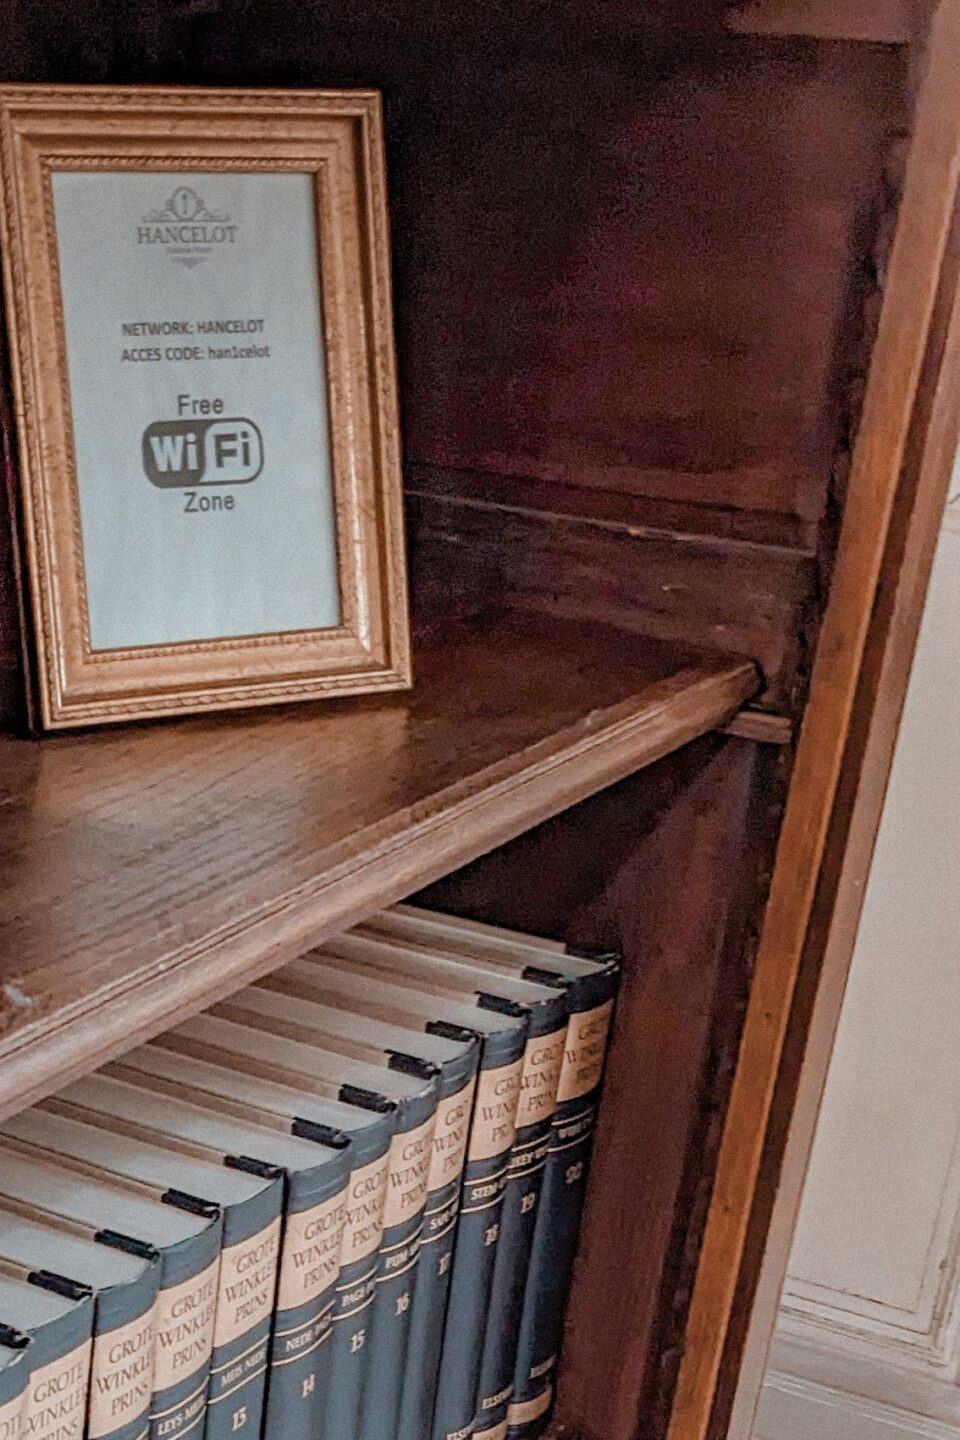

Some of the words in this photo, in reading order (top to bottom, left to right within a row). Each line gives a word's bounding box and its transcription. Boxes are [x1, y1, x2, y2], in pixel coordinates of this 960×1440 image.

[137, 225, 237, 245] HANCELOT
[121, 321, 194, 336] NETWORK:
[196, 319, 265, 334] HANCELOT
[121, 347, 162, 362] ACCES
[164, 346, 205, 361] CODE:
[177, 394, 224, 416] Free
[183, 491, 235, 514] Zone
[304, 1255, 336, 1289] PRINS
[234, 1290, 269, 1325] PRINS
[351, 1330, 365, 1353] 15
[171, 1337, 207, 1371] PRINS
[33, 1360, 83, 1403] GROTE
[301, 1373, 315, 1398] 14
